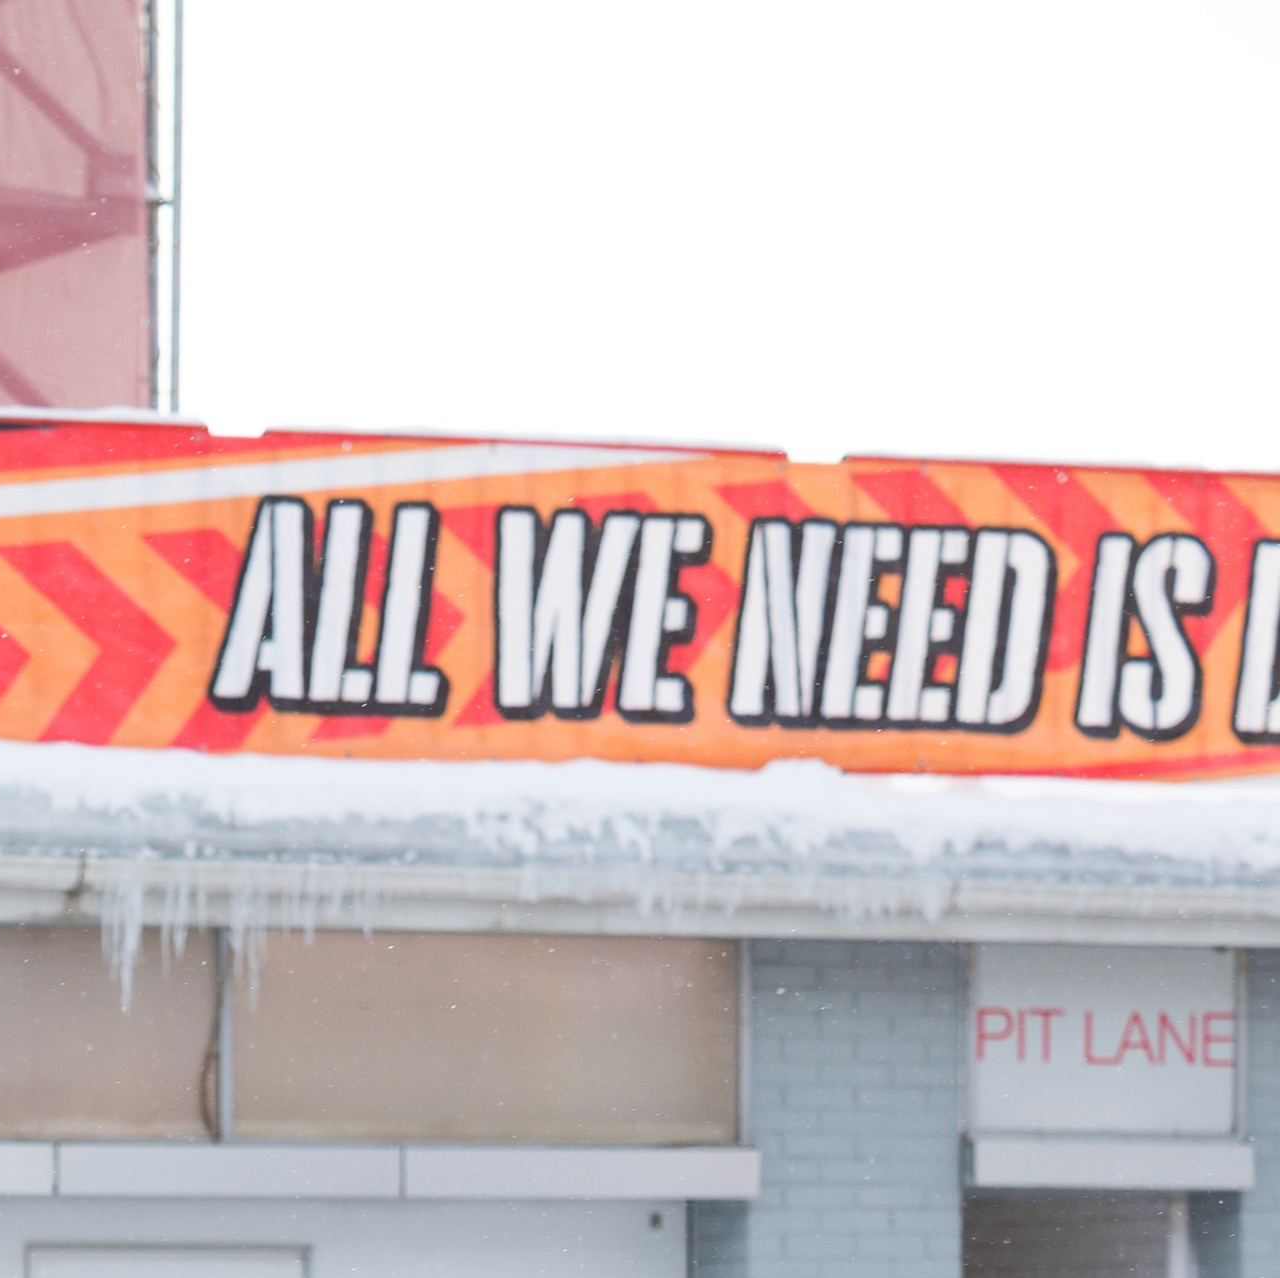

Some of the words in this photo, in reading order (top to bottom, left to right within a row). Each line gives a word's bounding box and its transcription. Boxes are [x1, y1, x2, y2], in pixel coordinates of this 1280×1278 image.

[209, 496, 449, 716] ALL
[494, 507, 713, 723] WE
[727, 516, 1057, 734] NEED
[1075, 531, 1216, 742] IS
[975, 1006, 1066, 1063] PIT
[1082, 1009, 1236, 1067] LANE
